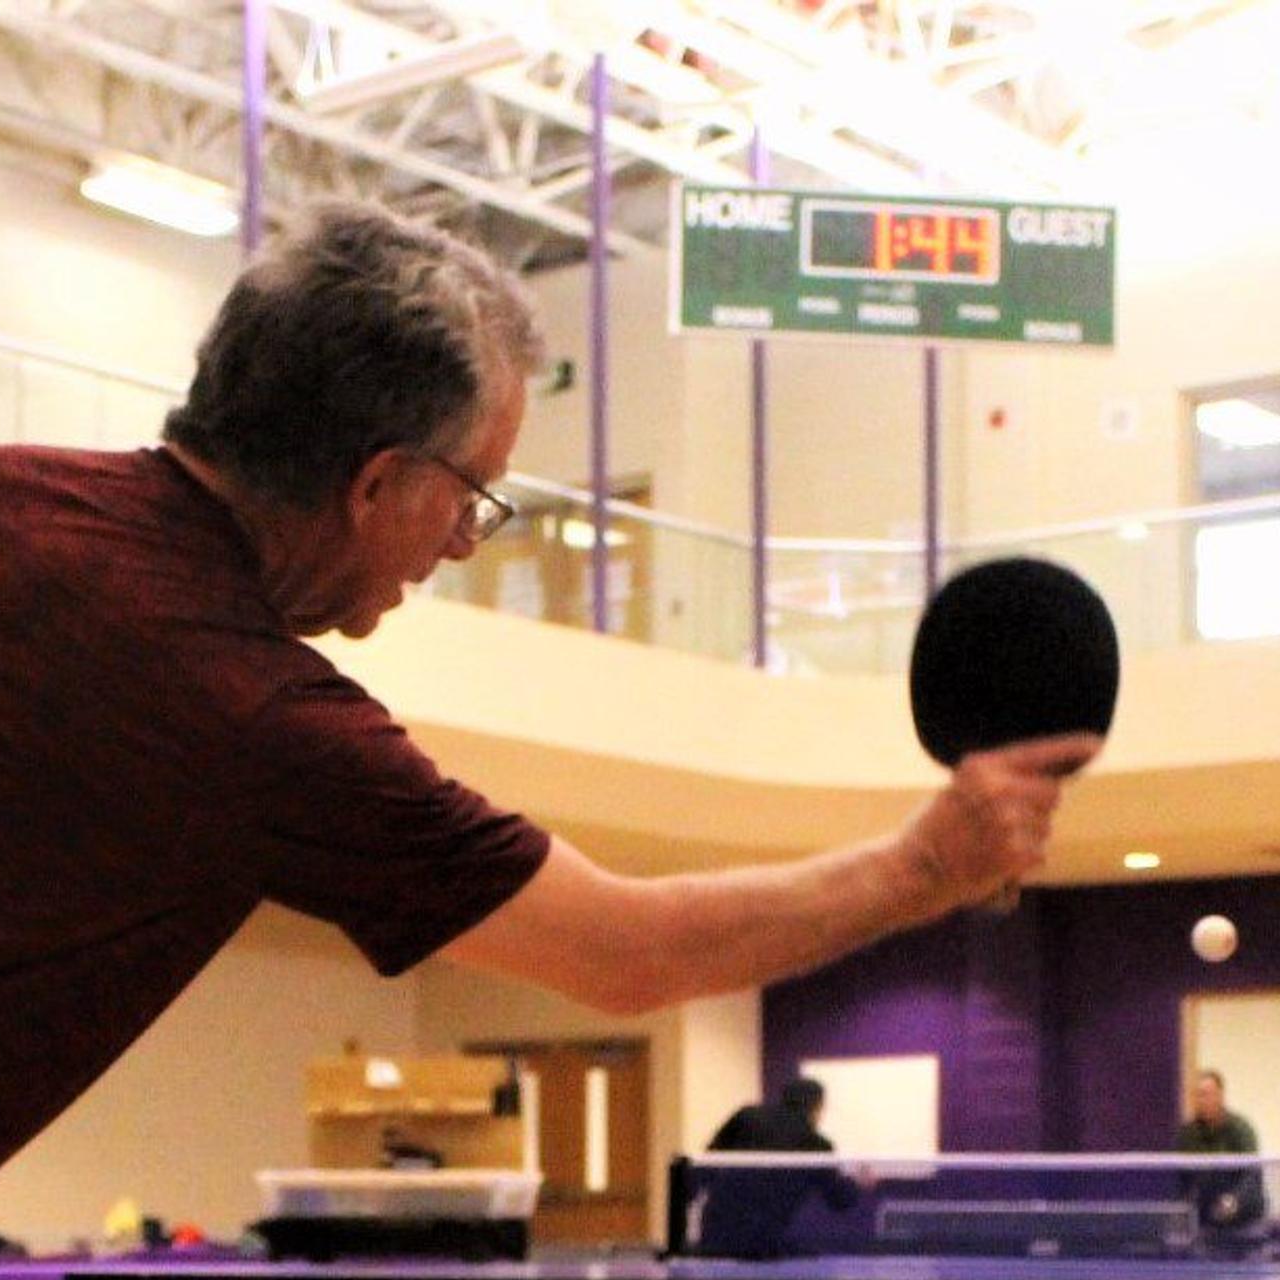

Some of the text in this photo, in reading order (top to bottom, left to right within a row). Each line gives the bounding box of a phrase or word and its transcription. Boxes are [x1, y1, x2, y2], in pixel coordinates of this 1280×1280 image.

[685, 191, 794, 231] HOME
[1007, 206, 1112, 248] GUEST
[874, 209, 995, 276] 1:44
